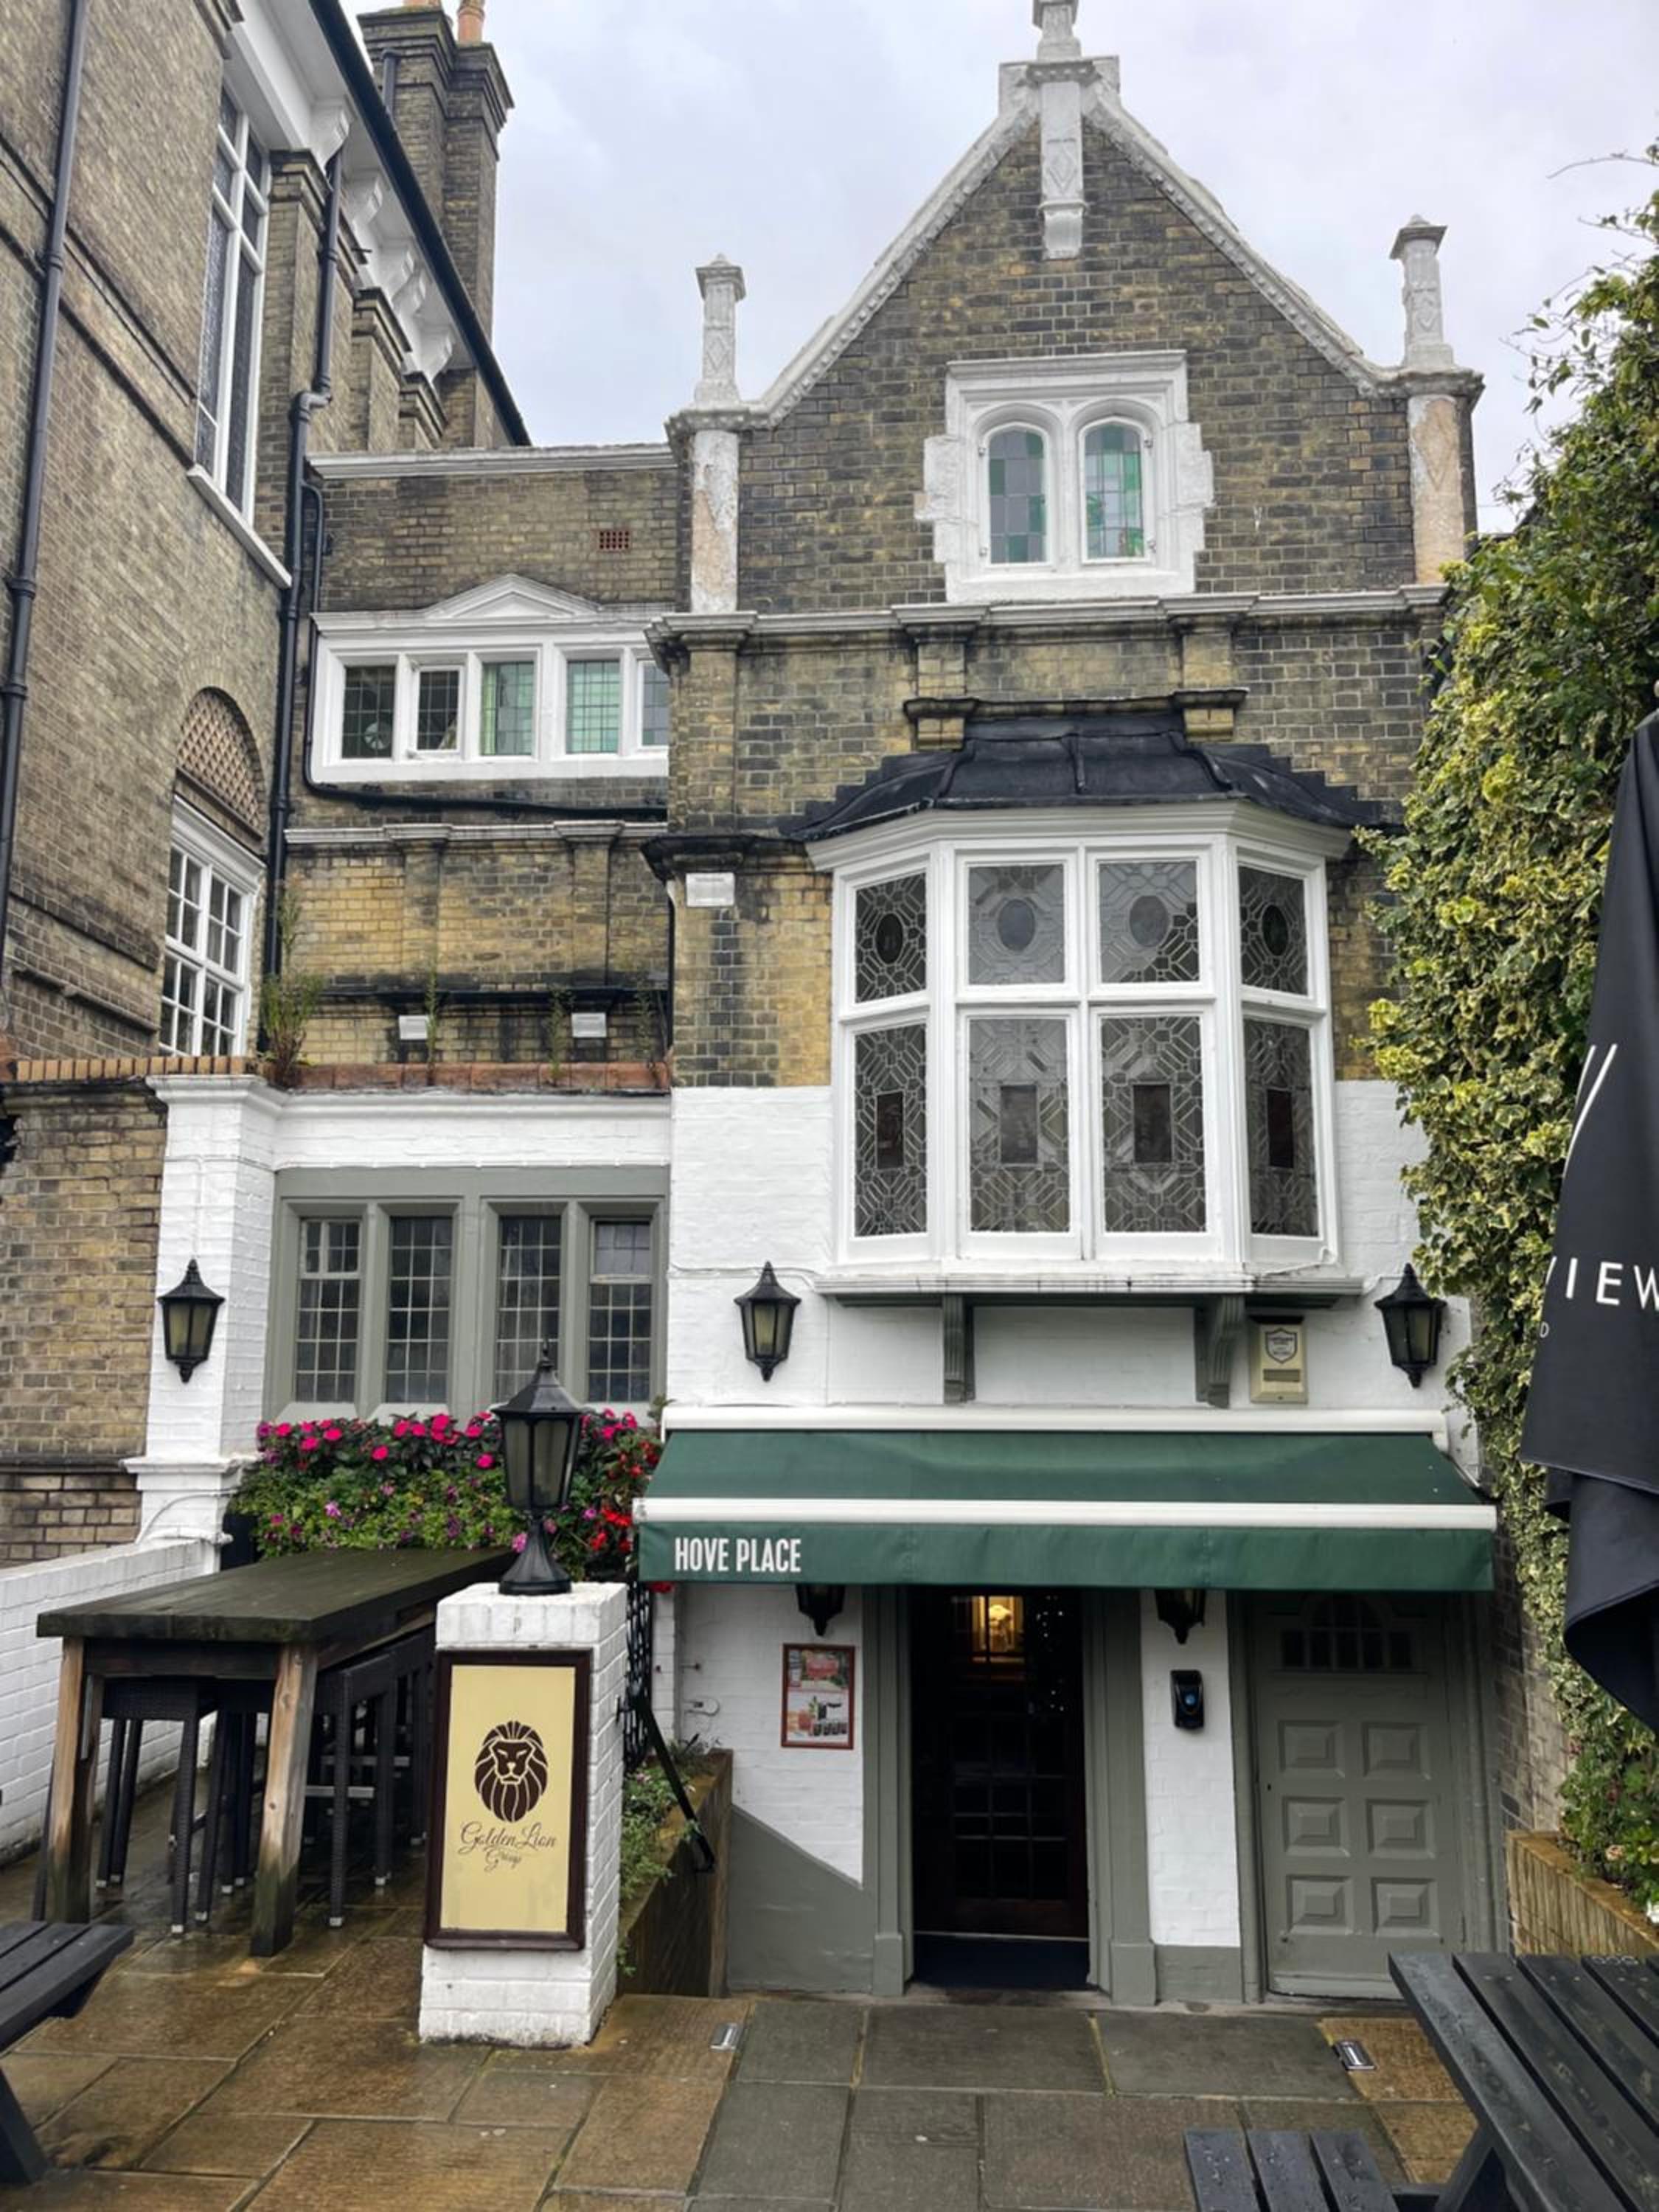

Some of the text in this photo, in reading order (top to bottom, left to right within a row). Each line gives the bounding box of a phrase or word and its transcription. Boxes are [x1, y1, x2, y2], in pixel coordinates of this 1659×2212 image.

[675, 1537, 801, 1572] HOVE PLACE
[458, 1820, 557, 1854] Golden Lion
